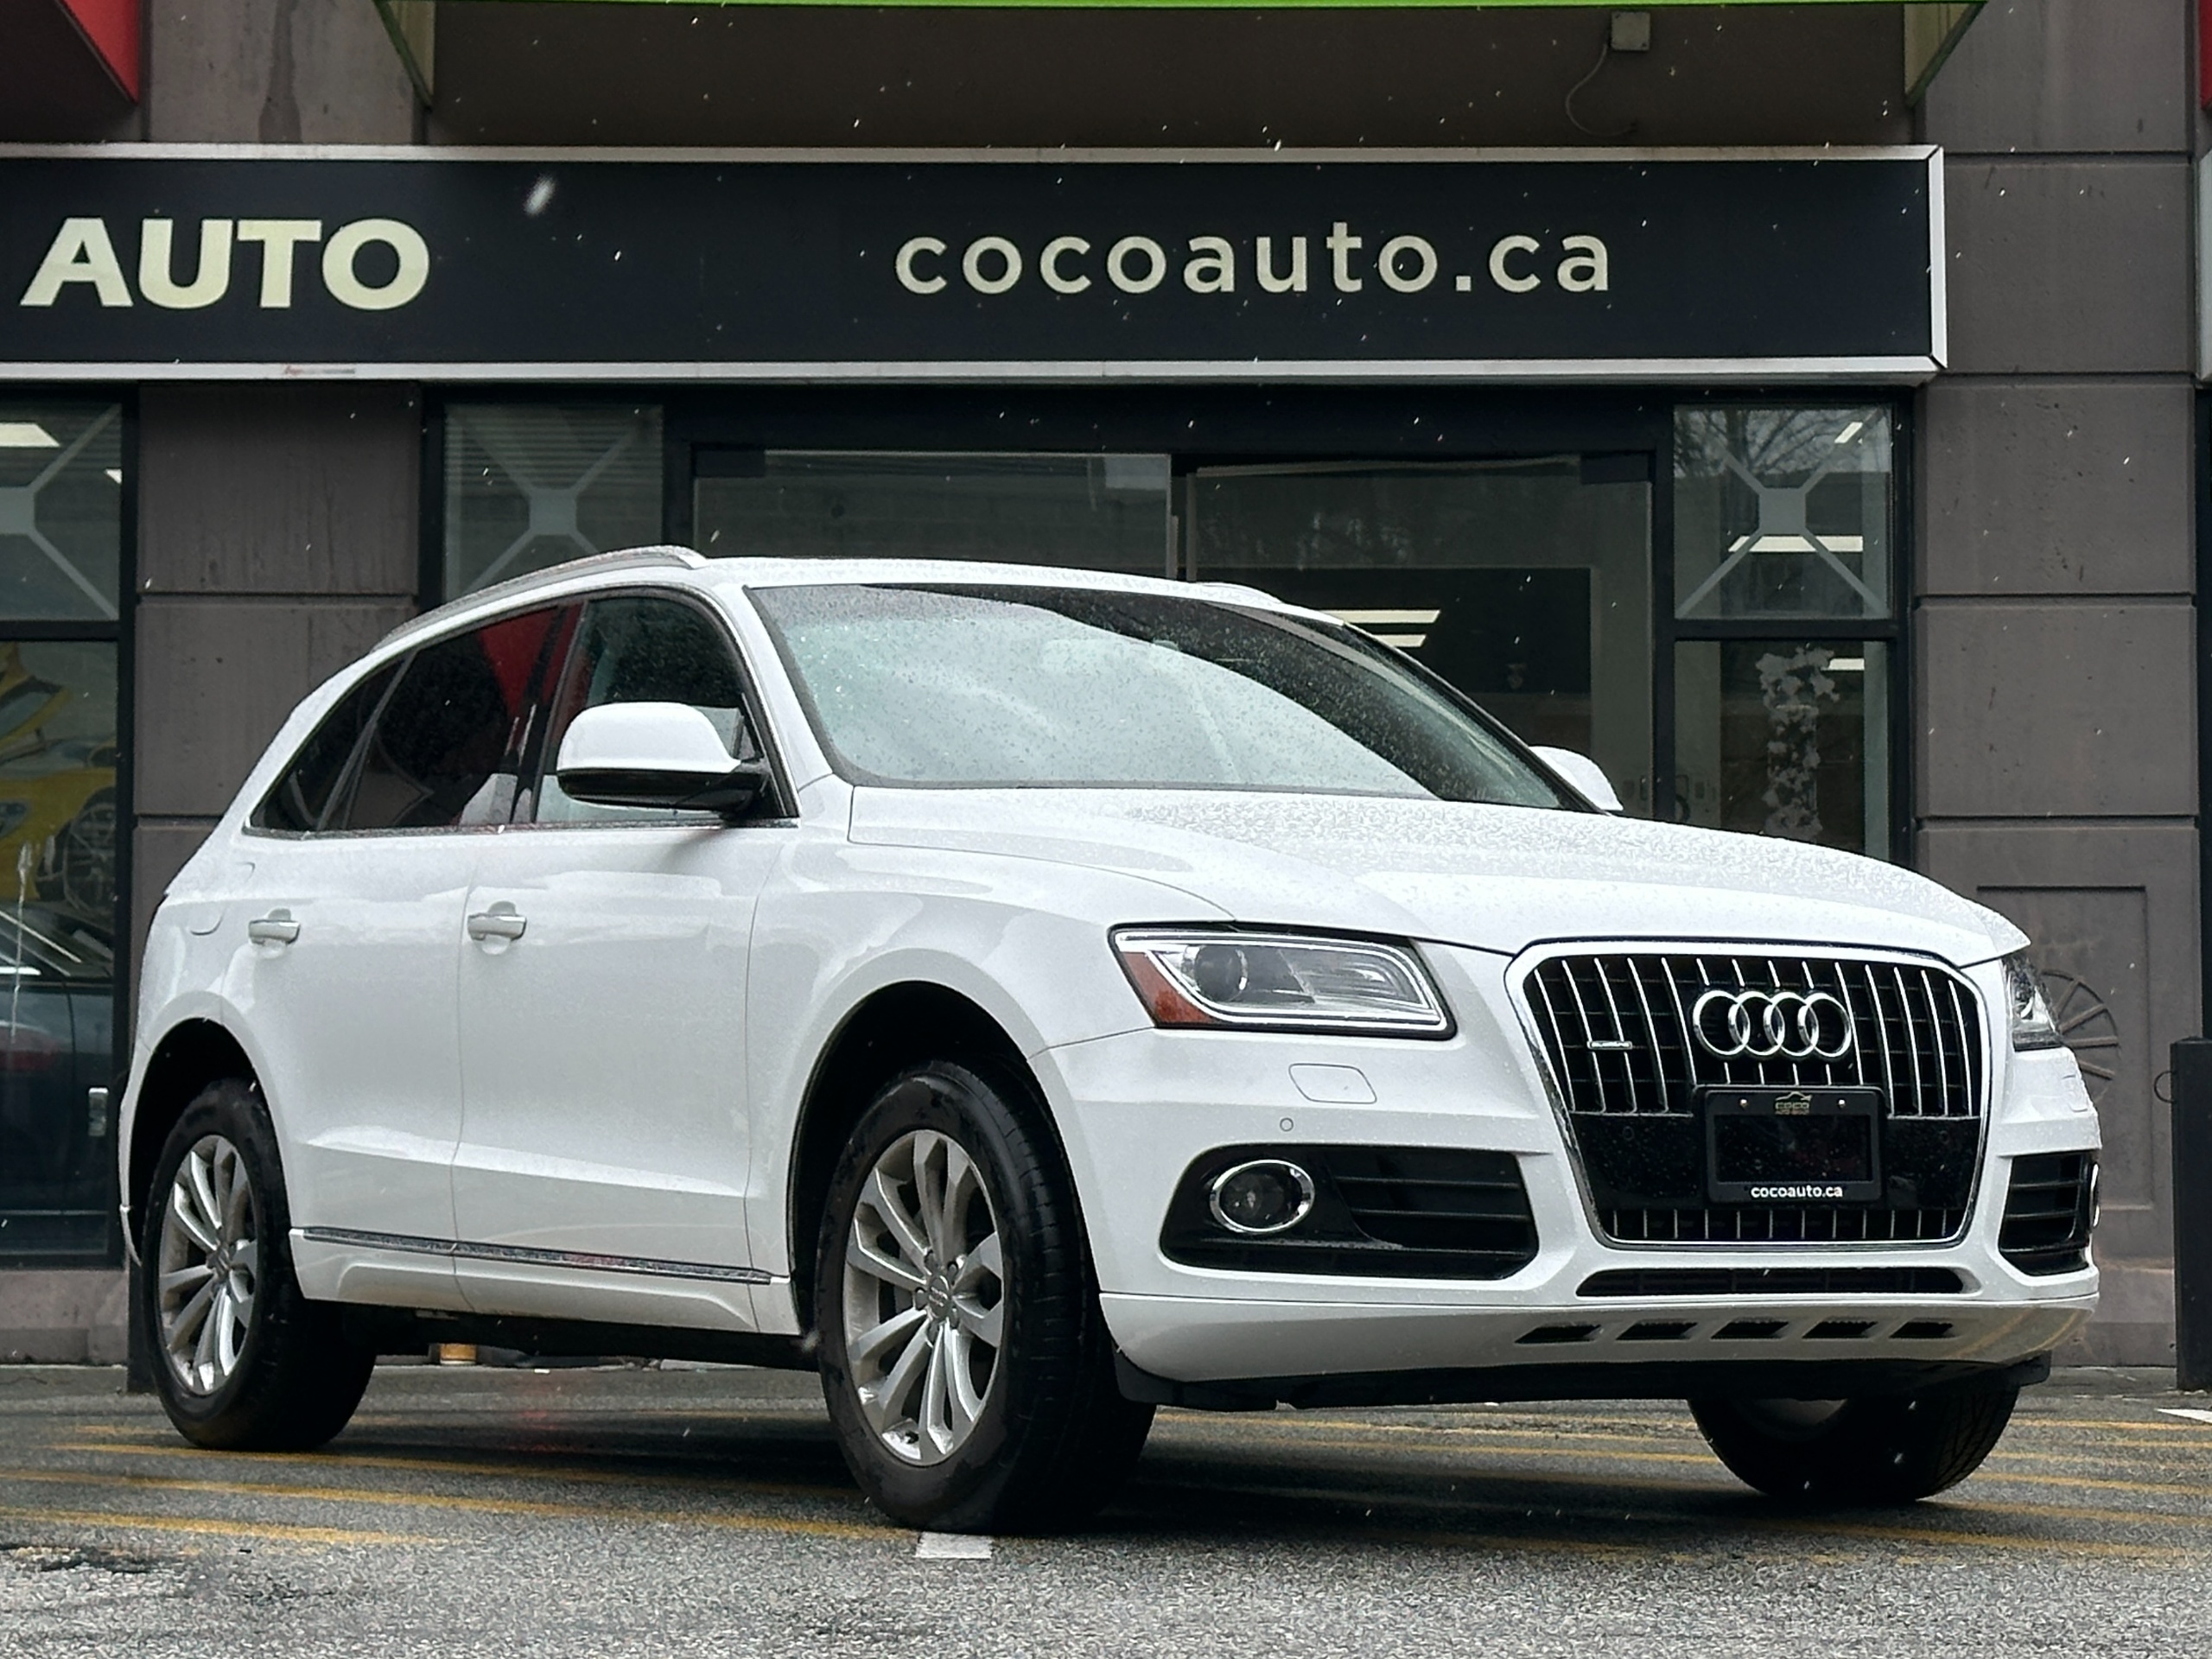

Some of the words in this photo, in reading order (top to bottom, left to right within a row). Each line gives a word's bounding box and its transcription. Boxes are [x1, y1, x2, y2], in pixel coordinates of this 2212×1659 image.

[21, 218, 430, 309] AUTO
[895, 223, 1609, 294] cocoauto.ca
[1751, 1185, 1843, 1198] cocoauto.ca
